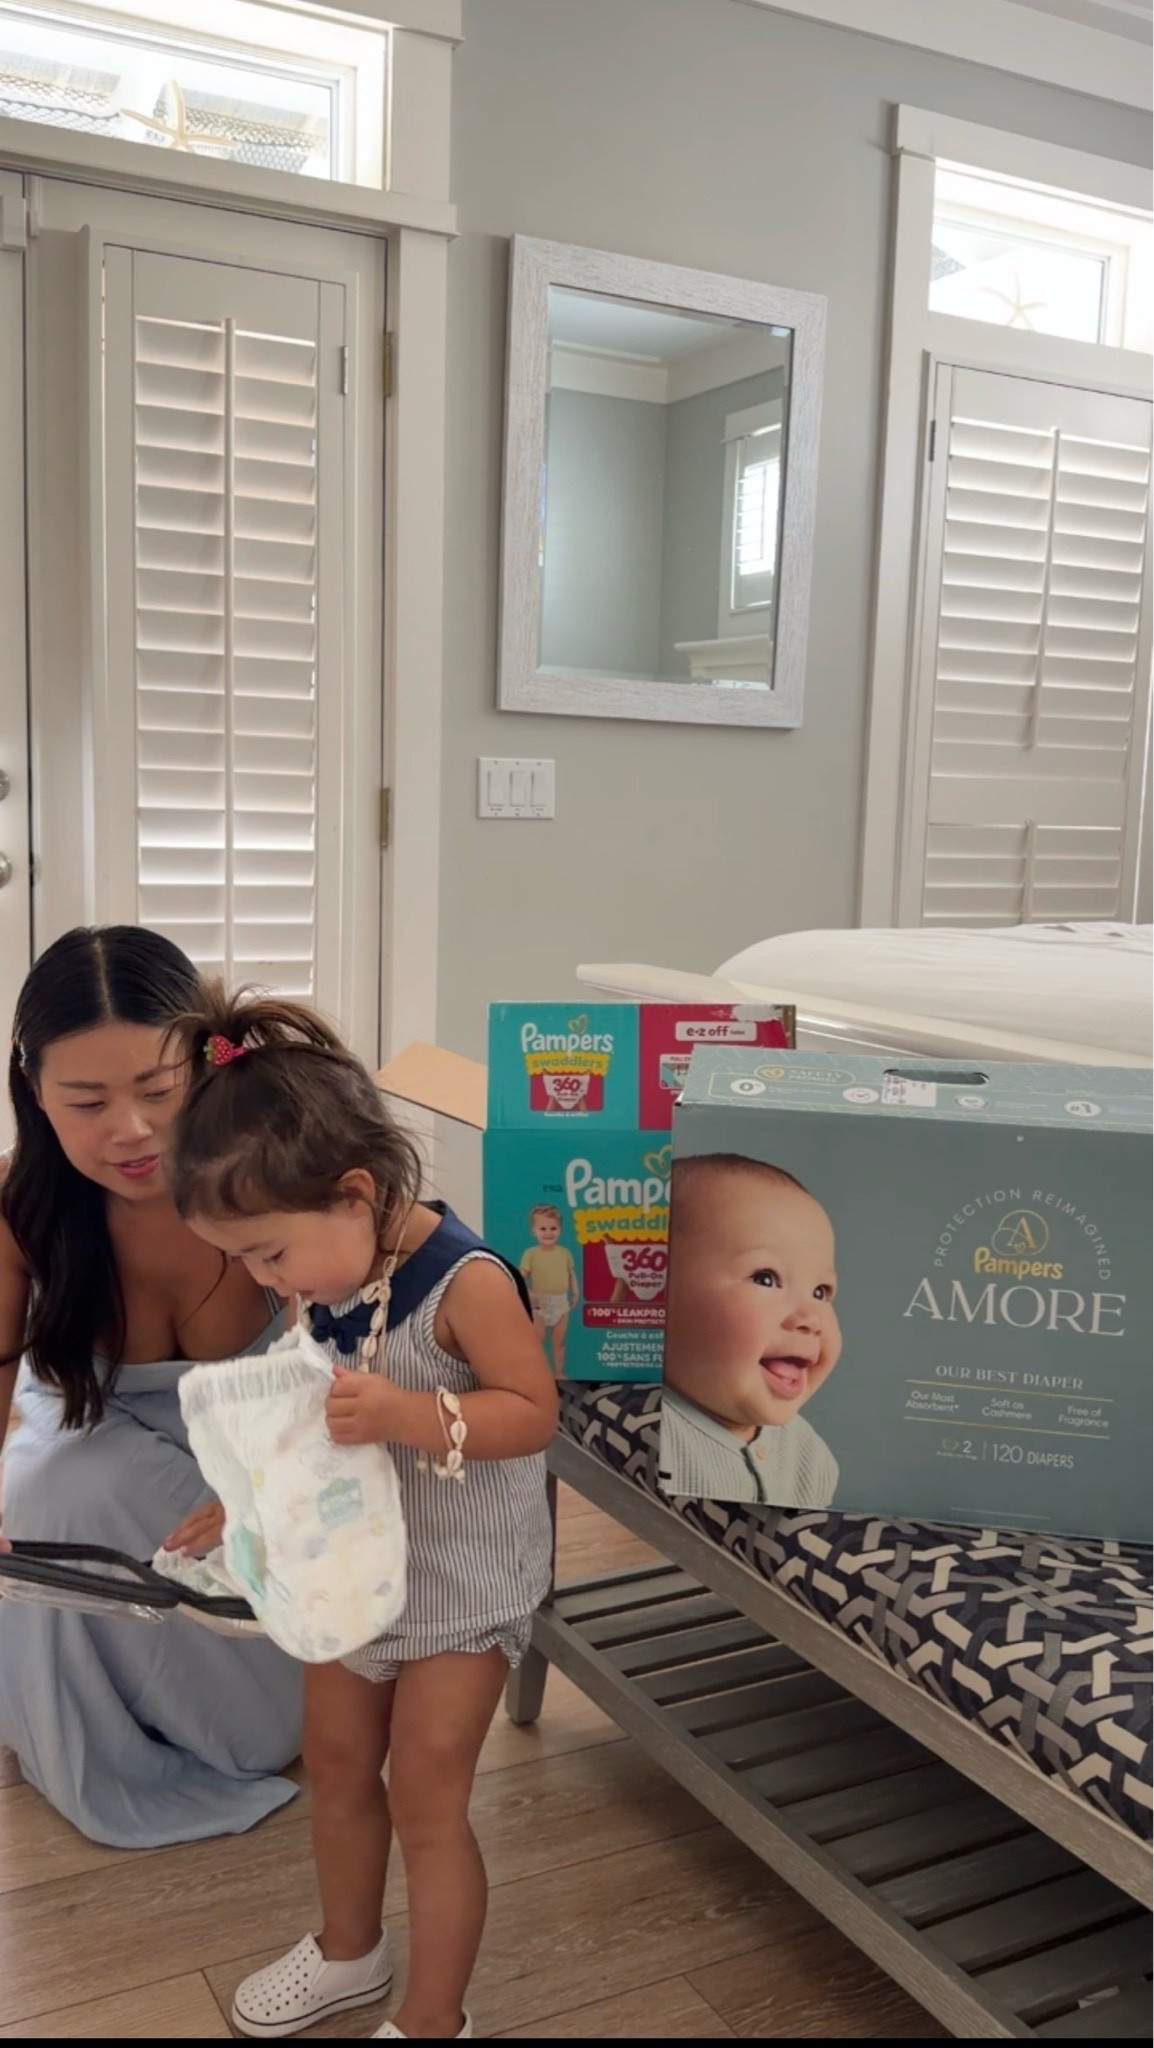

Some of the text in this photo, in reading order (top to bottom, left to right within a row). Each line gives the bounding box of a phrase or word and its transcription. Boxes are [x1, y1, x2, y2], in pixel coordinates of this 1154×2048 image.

[708, 1025, 729, 1037] off
[521, 1022, 613, 1055] Pampers
[532, 1056, 603, 1069] swaddlers
[552, 1077, 581, 1092] 360
[934, 1188, 1111, 1281] PROTECTION REIMAGINED
[621, 1247, 669, 1272] 360
[973, 1247, 1063, 1281] Pampers
[628, 1272, 664, 1280] Pull-On
[630, 1281, 662, 1289] Diaper
[902, 1276, 1127, 1337] AMORE
[623, 1353, 651, 1363] SANS
[935, 1365, 1084, 1390] OUR BEST DIAPER
[910, 1390, 955, 1402] Our Most
[990, 1398, 1025, 1411] Soft as
[1067, 1405, 1103, 1418] Free of
[981, 1406, 1032, 1420] Cashmere
[1058, 1414, 1110, 1429] Fragrance
[962, 1440, 973, 1454] 2
[992, 1443, 1023, 1464] 120
[1027, 1451, 1074, 1469] DIAPERS
